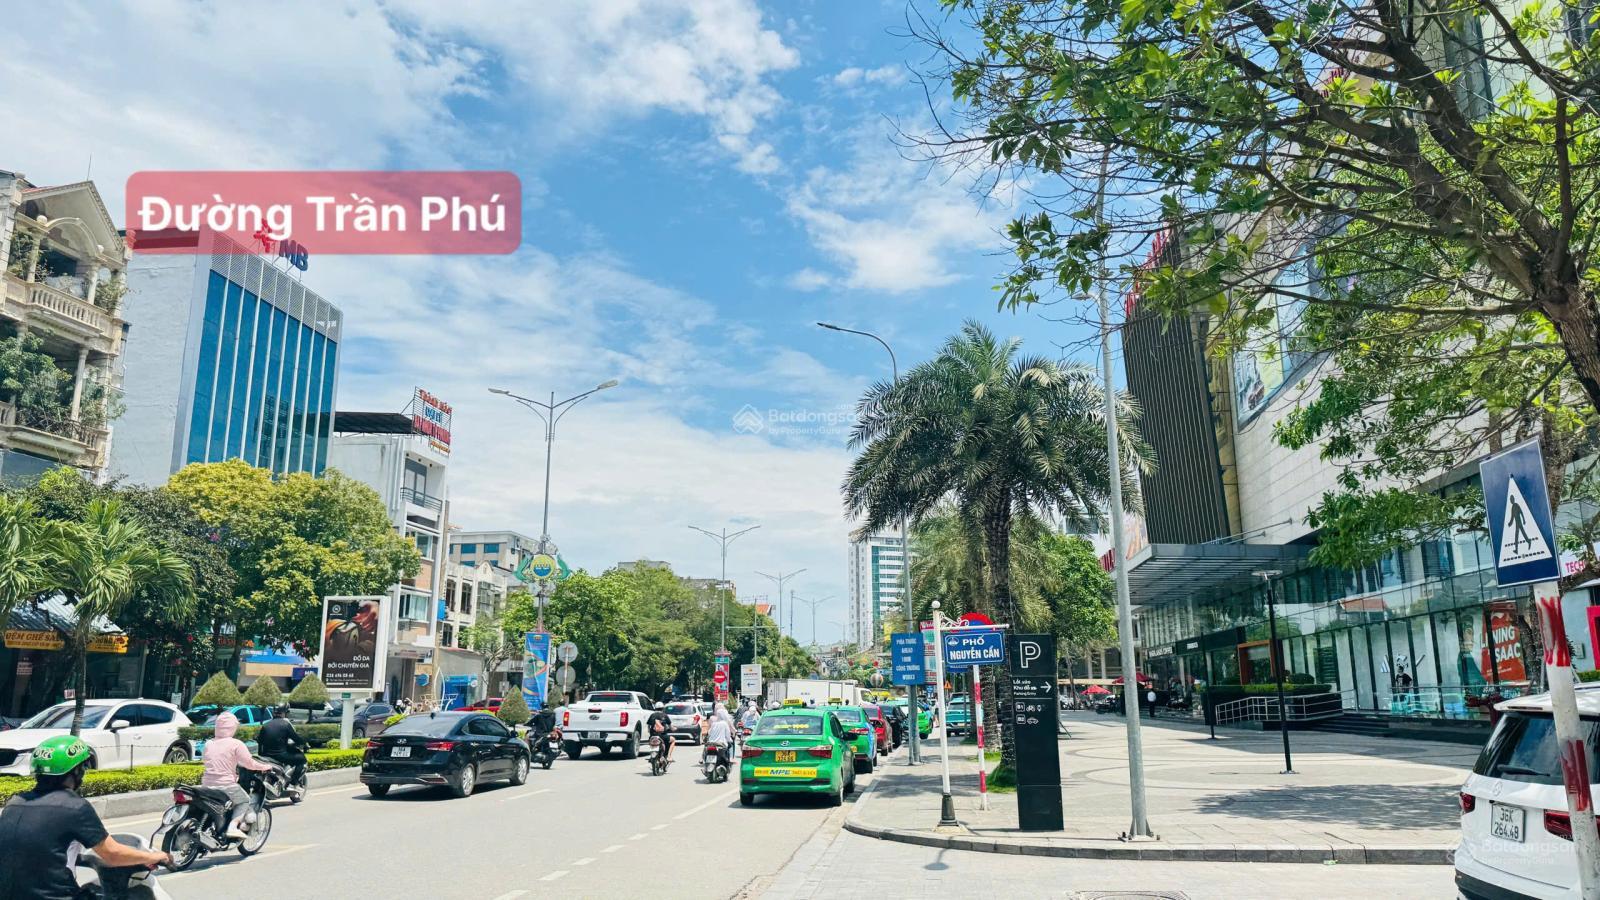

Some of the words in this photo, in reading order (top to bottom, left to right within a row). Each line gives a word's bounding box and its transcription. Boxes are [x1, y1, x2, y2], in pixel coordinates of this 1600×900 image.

[279, 239, 308, 271] MB
[962, 634, 984, 645] PHỐ
[1020, 642, 1041, 668] P
